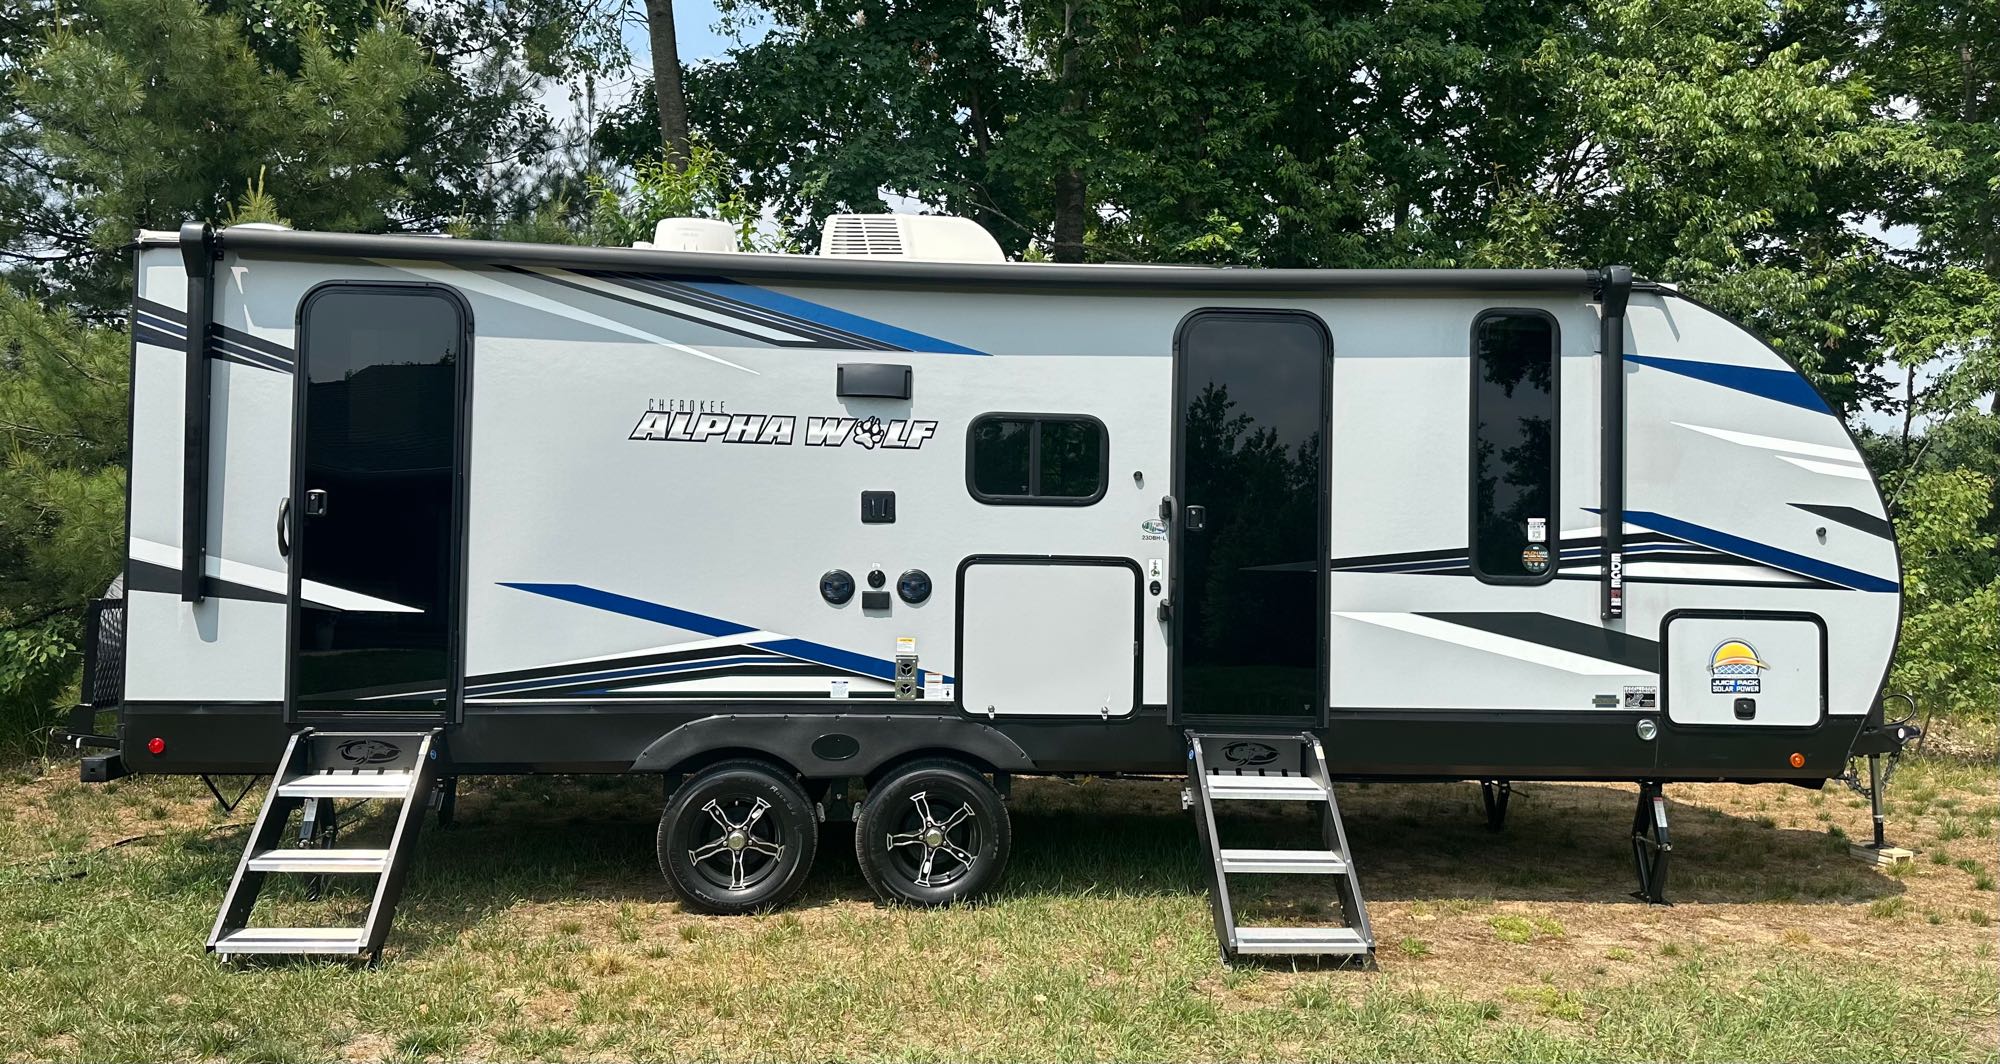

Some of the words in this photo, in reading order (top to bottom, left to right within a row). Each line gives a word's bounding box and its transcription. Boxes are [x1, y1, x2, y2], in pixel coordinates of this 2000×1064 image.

[649, 399, 726, 413] CHEROKEE
[628, 411, 796, 445] ALPHA
[804, 416, 939, 449] WOLF
[1611, 553, 1621, 588] EDGE
